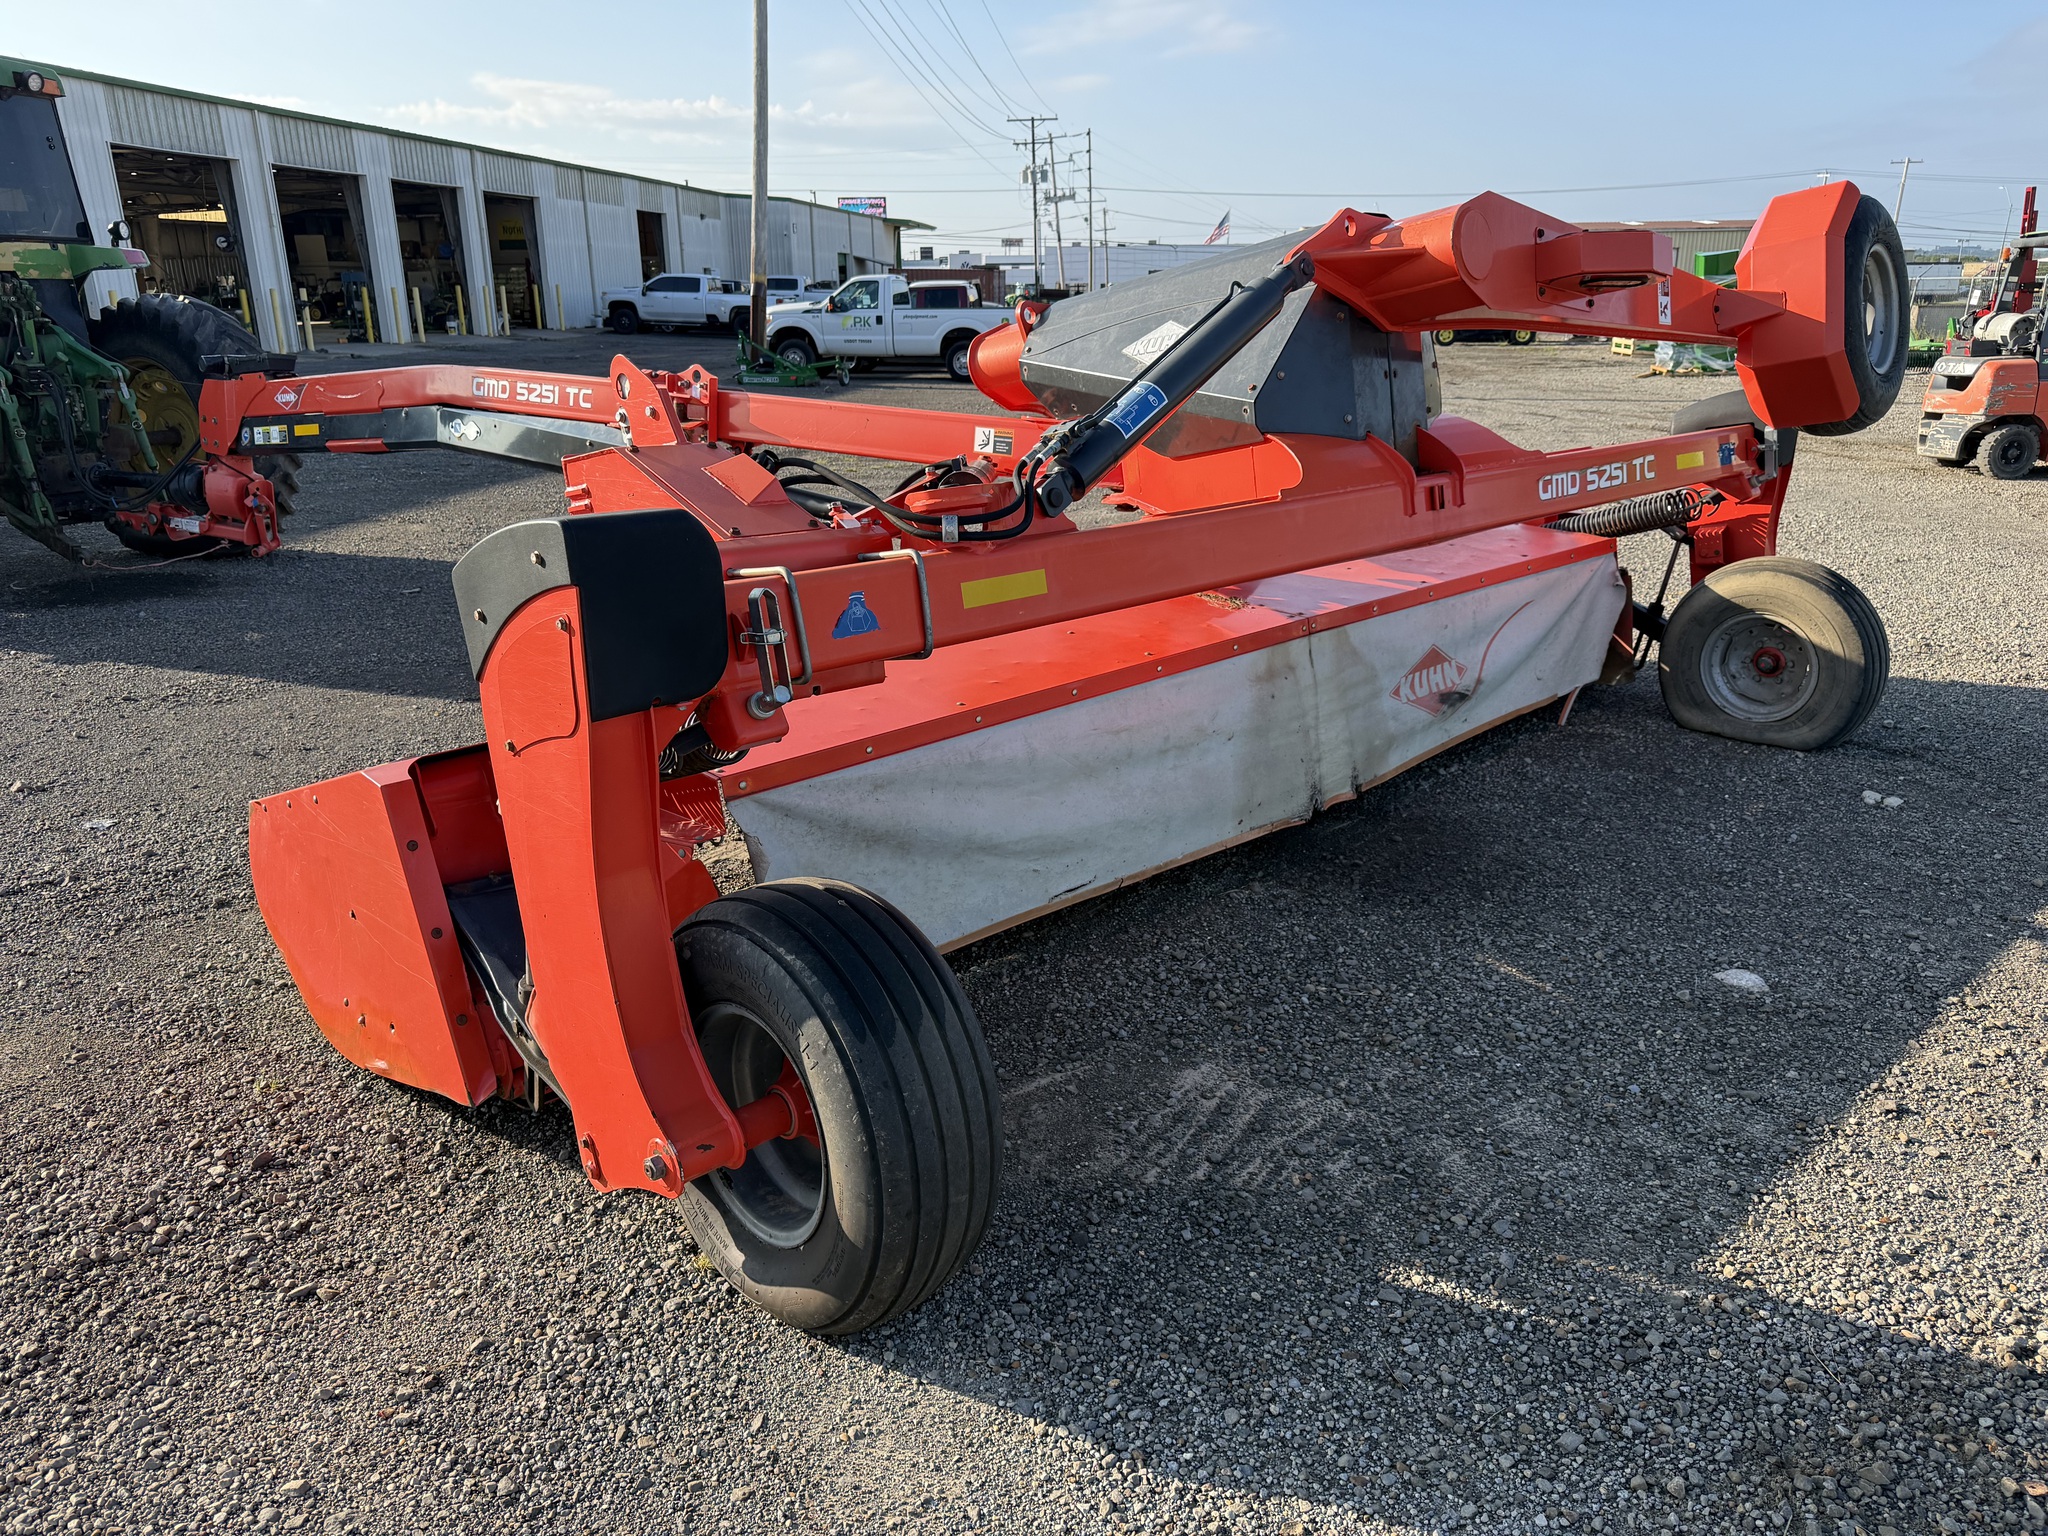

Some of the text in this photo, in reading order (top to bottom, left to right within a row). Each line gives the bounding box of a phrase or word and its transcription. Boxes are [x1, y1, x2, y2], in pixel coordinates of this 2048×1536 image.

[502, 225, 524, 235] NOTHI
[1131, 333, 1178, 356] KUH
[277, 393, 295, 403] KUHN
[472, 377, 593, 409] GMD 5251 TC
[1538, 454, 1655, 501] GMD 5251 TC
[1400, 659, 1460, 704] KUHN
[736, 962, 804, 1041] SPECIALIST
[695, 1198, 709, 1223] INDIA
[714, 1230, 729, 1251] MADE
